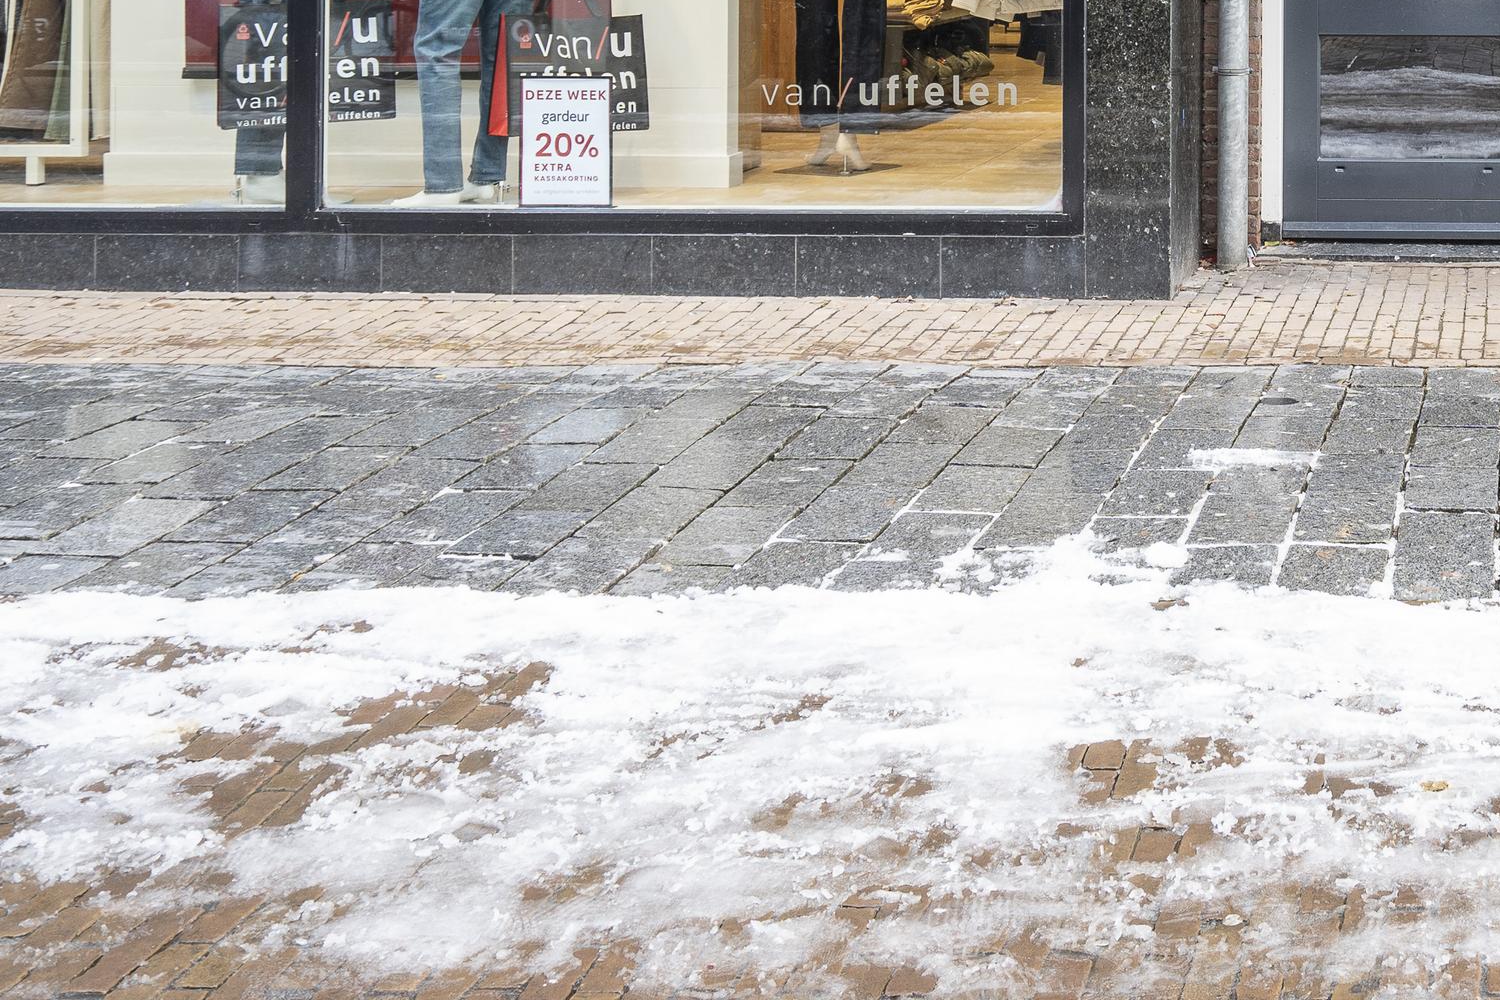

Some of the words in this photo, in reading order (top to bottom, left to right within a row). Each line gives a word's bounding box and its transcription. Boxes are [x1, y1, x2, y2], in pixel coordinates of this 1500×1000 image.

[535, 26, 633, 61] van/u
[525, 89, 562, 101] DEZE
[567, 89, 607, 101] WEEK
[762, 75, 1018, 107] van/uffelen
[541, 110, 590, 125] gardeur
[535, 132, 599, 158] 20%
[534, 163, 573, 172] EXTRA
